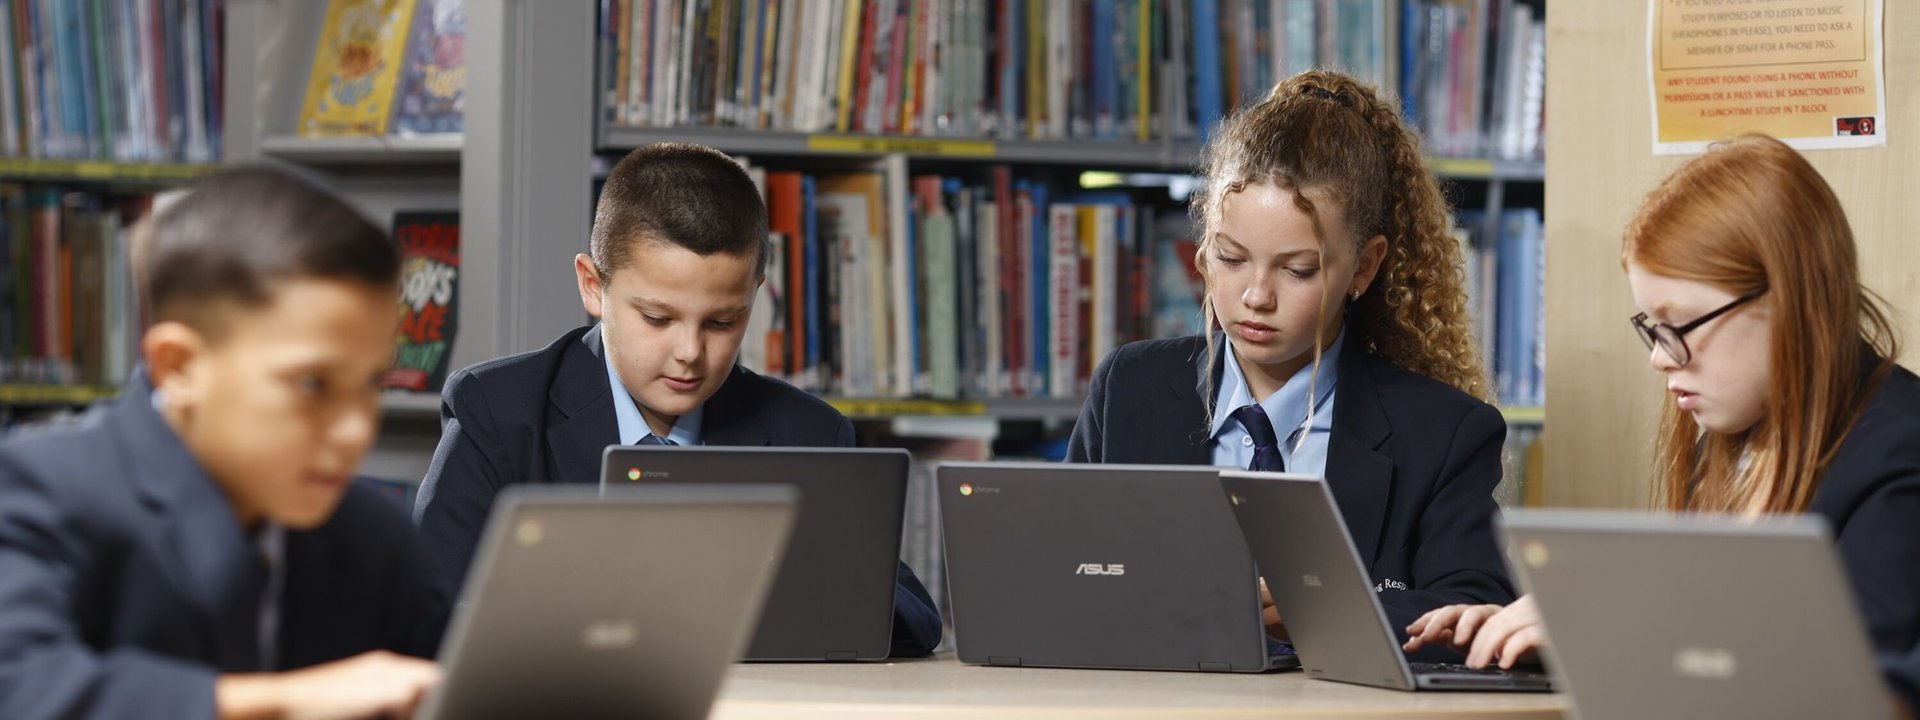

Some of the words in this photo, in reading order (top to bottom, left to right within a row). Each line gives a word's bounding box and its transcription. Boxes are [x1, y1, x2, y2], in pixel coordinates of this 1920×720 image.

[1681, 13, 1706, 23] STUDY
[1708, 11, 1748, 21] PURPOSES
[1750, 10, 1761, 19] OR
[1764, 9, 1775, 18] TO
[1776, 8, 1803, 18] LISTEN
[1805, 7, 1816, 17] TO
[1817, 5, 1844, 15] MUSIC
[1730, 27, 1739, 36] IN
[1775, 25, 1792, 34] YOU
[1794, 24, 1816, 33] NEED
[1817, 23, 1828, 32] TO
[1830, 22, 1845, 31] ASK
[1847, 22, 1853, 30] A
[1687, 45, 1722, 55] MEMBER
[1724, 45, 1735, 54] OF
[1737, 43, 1758, 53] STAFF
[1760, 42, 1777, 52] FOR
[1786, 41, 1813, 50] PHONE
[1667, 78, 1684, 87] ANY
[1685, 76, 1720, 86] STUDENT
[1722, 74, 1752, 84] FOUND
[1753, 73, 1778, 83] USING
[1788, 71, 1816, 81] PHONE
[1818, 70, 1859, 80] WITHOUT
[1664, 93, 1711, 103] PERMISSION
[1712, 92, 1723, 101] OR
[1734, 91, 1754, 100] PASS
[1755, 90, 1774, 99] WILL
[1776, 89, 1785, 98] BE
[1788, 87, 1841, 97] SANCTIONED
[1843, 86, 1865, 95] WITH
[1708, 107, 1752, 117] LUNCHTIME
[1755, 106, 1781, 115] STUDY
[1783, 105, 1793, 114] IN
[1801, 104, 1828, 113] BLOCK
[1075, 563, 1125, 575] ASUS
